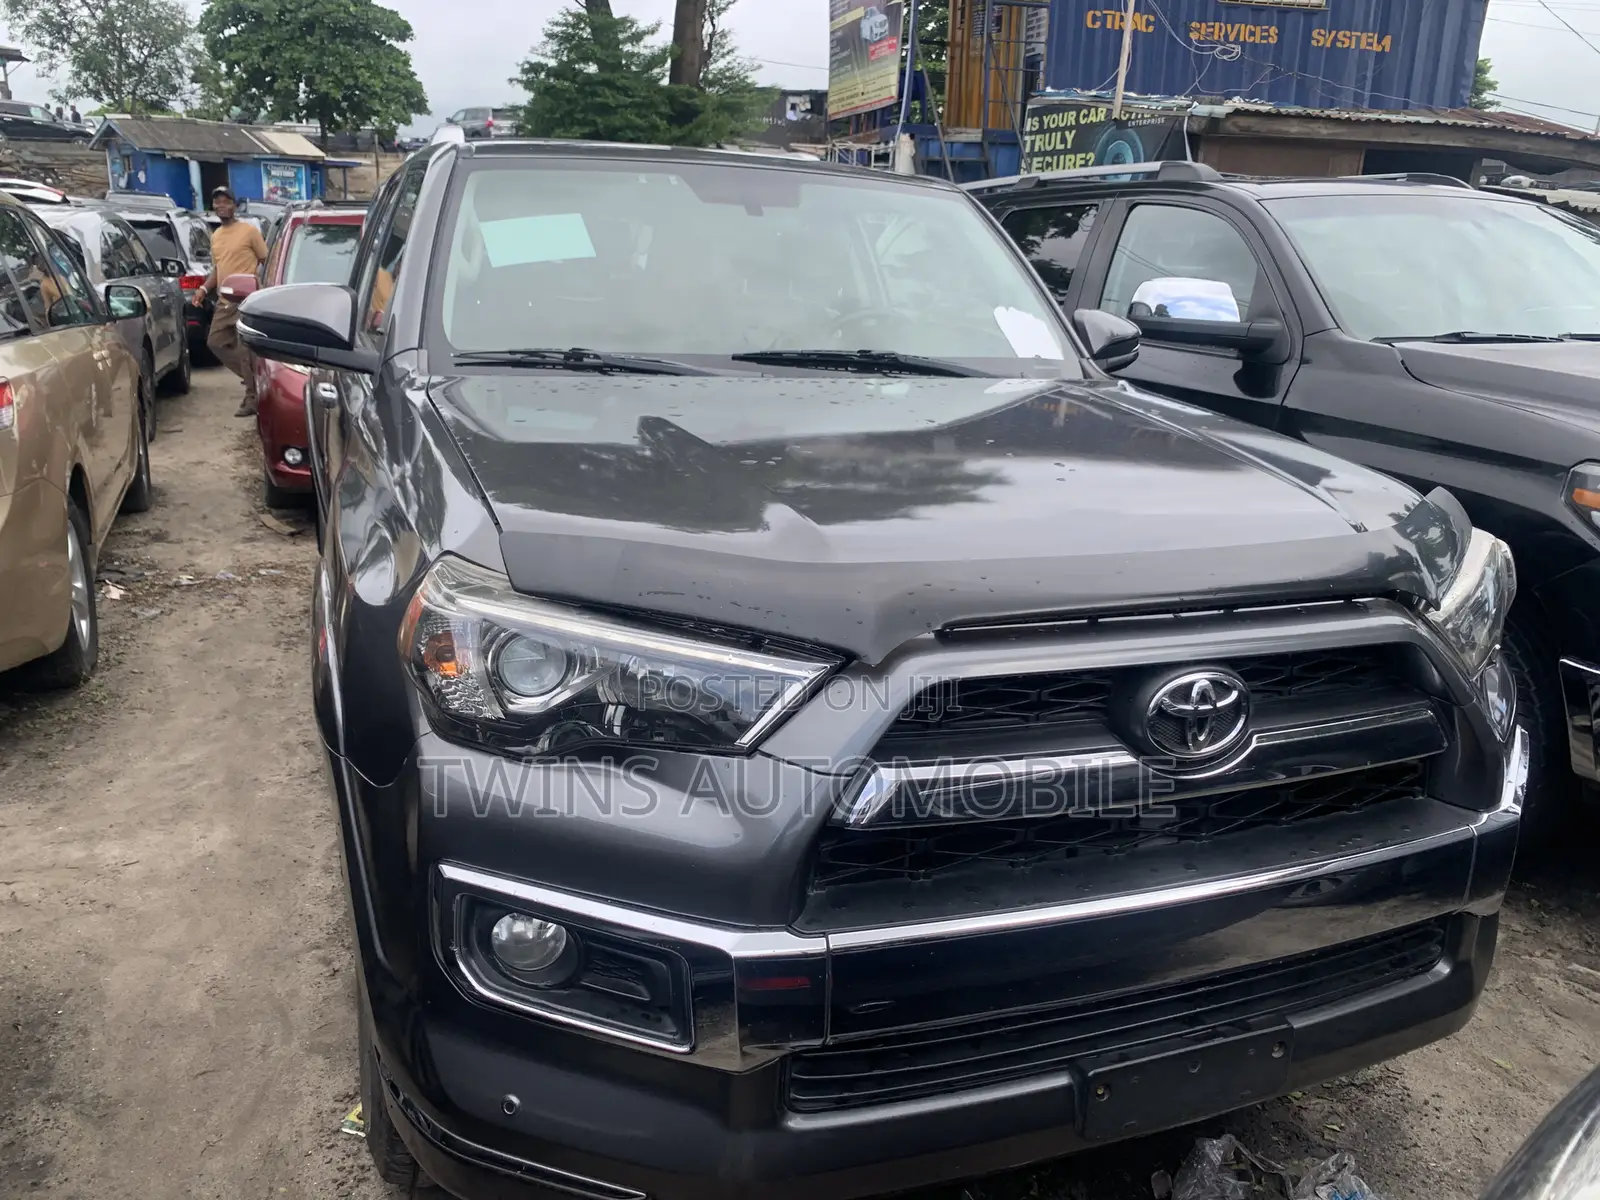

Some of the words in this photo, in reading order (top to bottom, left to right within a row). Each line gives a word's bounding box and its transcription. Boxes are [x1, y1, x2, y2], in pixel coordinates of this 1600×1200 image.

[1189, 21, 1279, 45] SERVICES
[1311, 28, 1392, 52] SYSTEM
[1025, 116, 1040, 132] IS
[1042, 110, 1078, 130] YOUR
[1079, 107, 1107, 125] CAR
[1128, 117, 1165, 128] ENTERPRISE
[1024, 129, 1076, 153] TRULY
